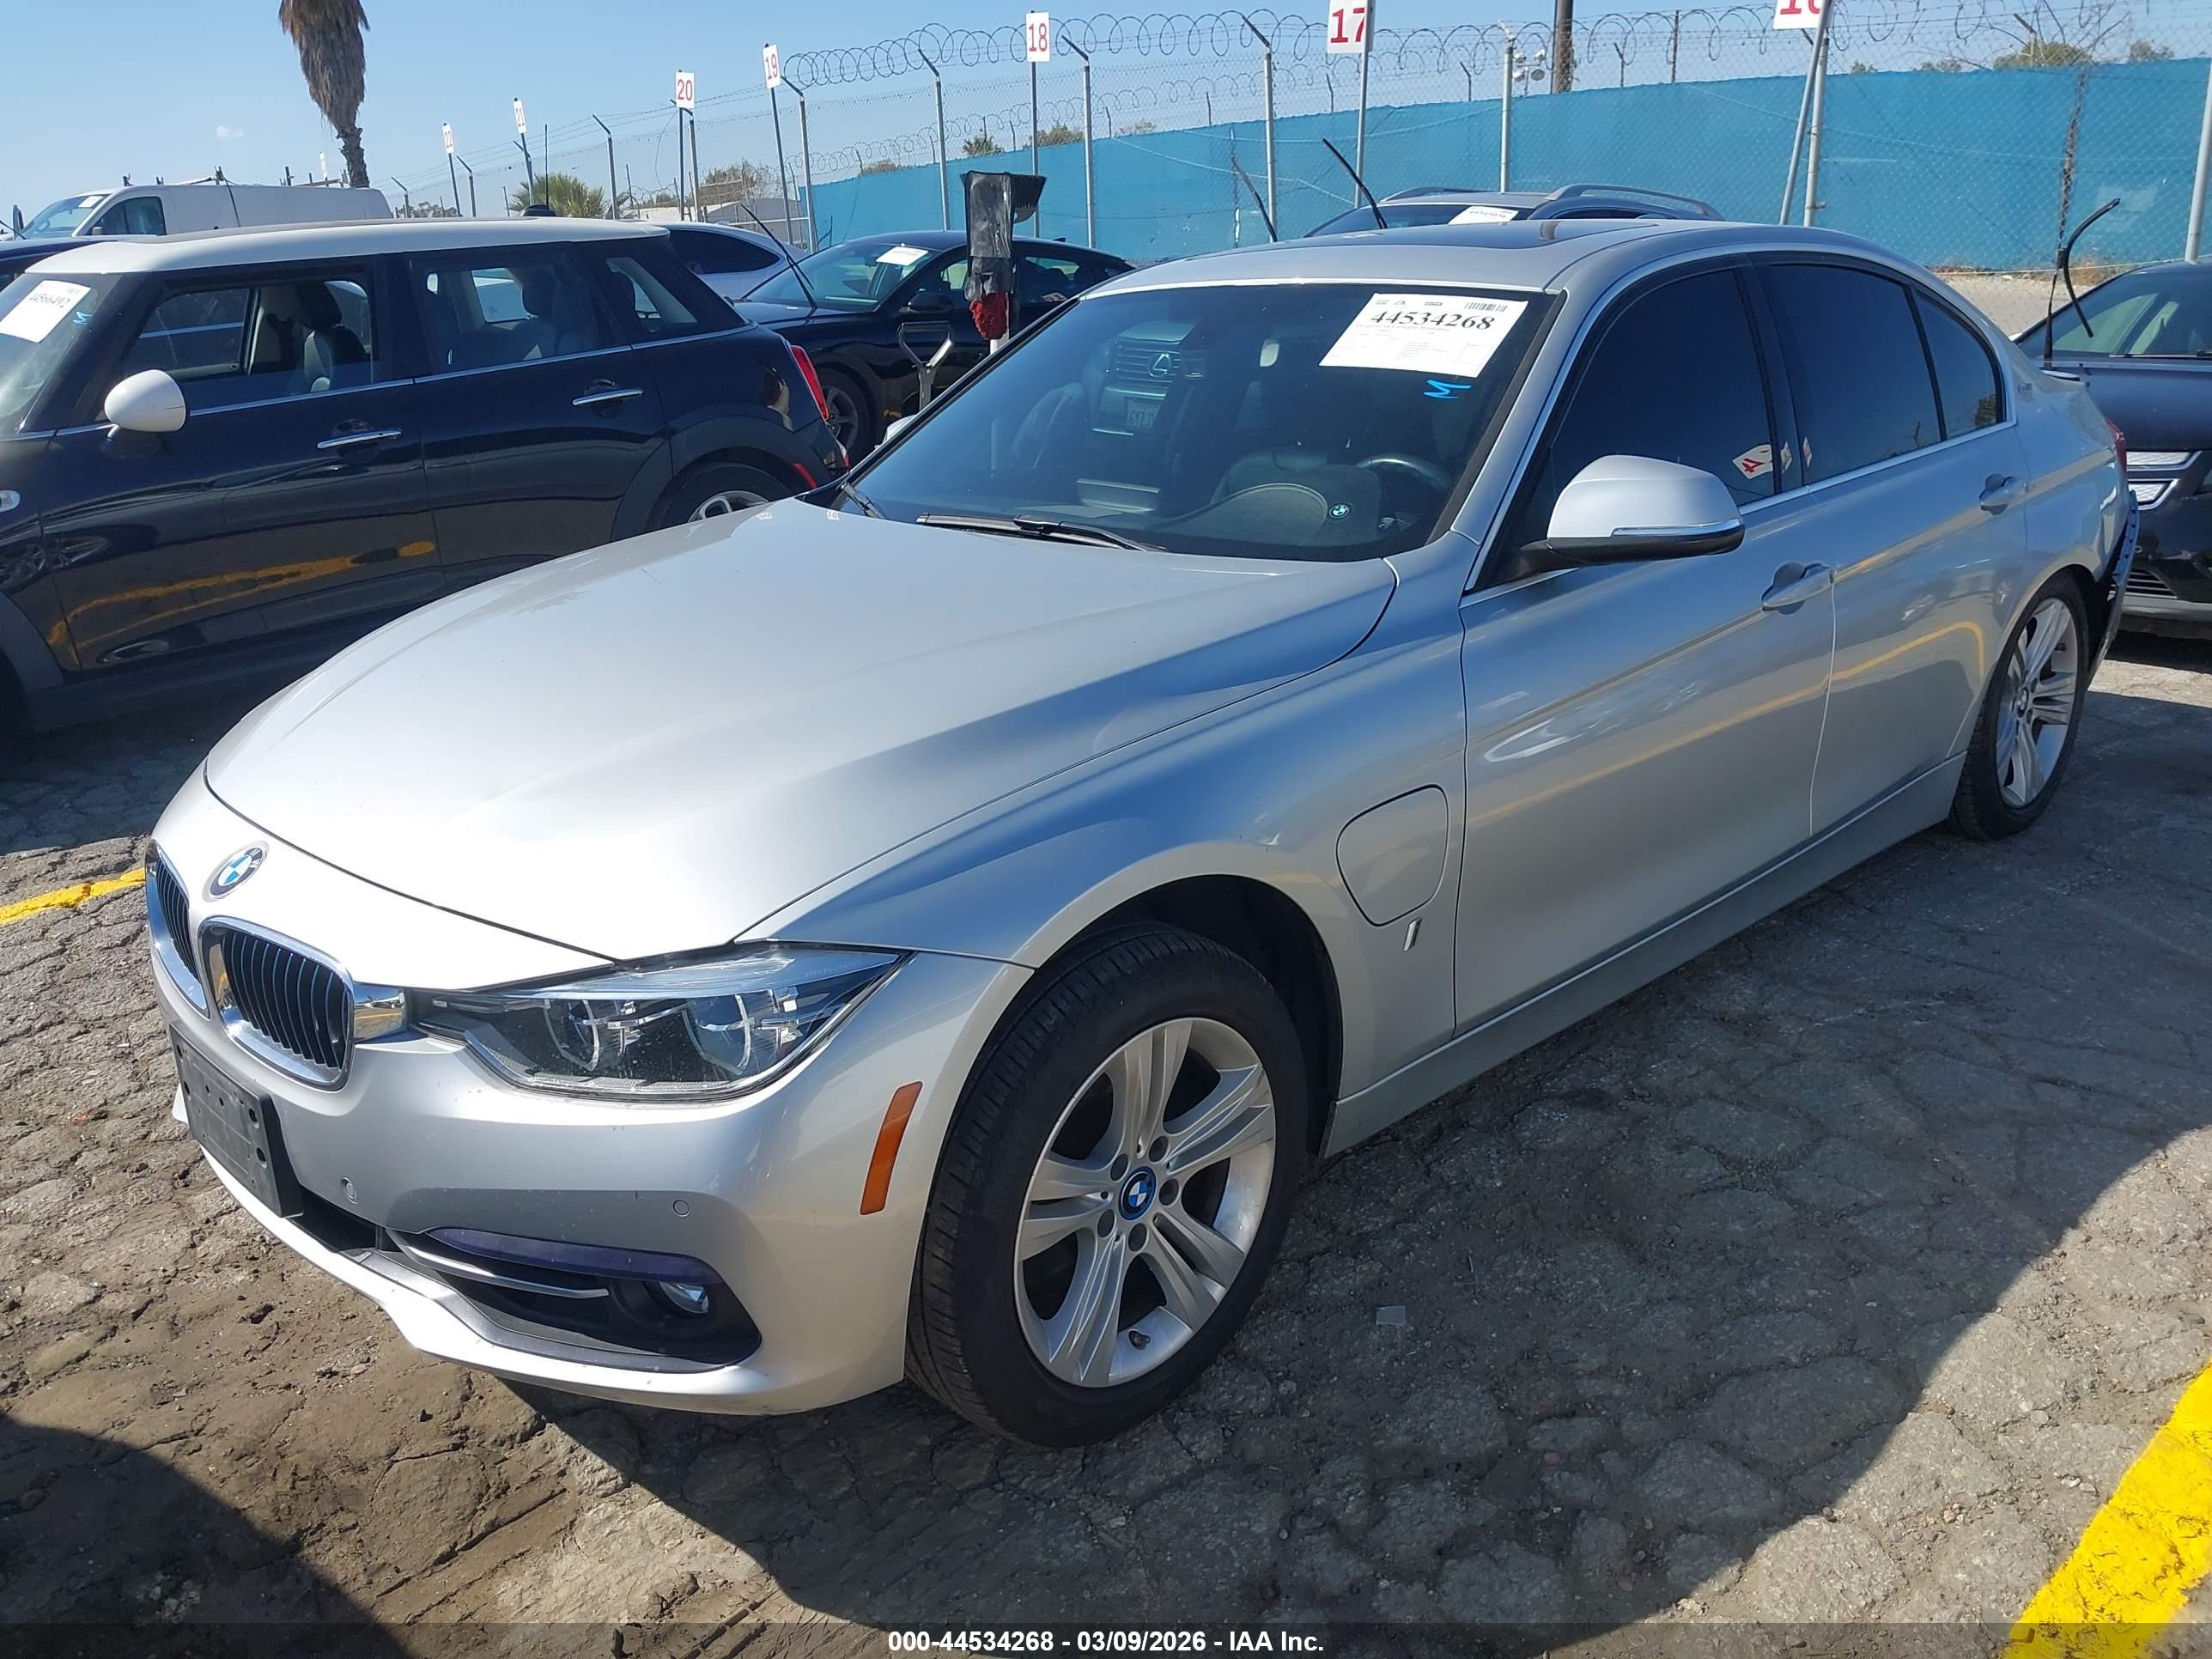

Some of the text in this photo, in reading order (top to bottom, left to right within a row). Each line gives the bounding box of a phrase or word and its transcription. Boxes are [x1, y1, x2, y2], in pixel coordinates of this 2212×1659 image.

[1028, 22, 1048, 52] 18
[1330, 7, 1365, 44] 17
[765, 53, 778, 80] 19
[677, 78, 693, 101] 20
[1370, 311, 1495, 331] 44534268
